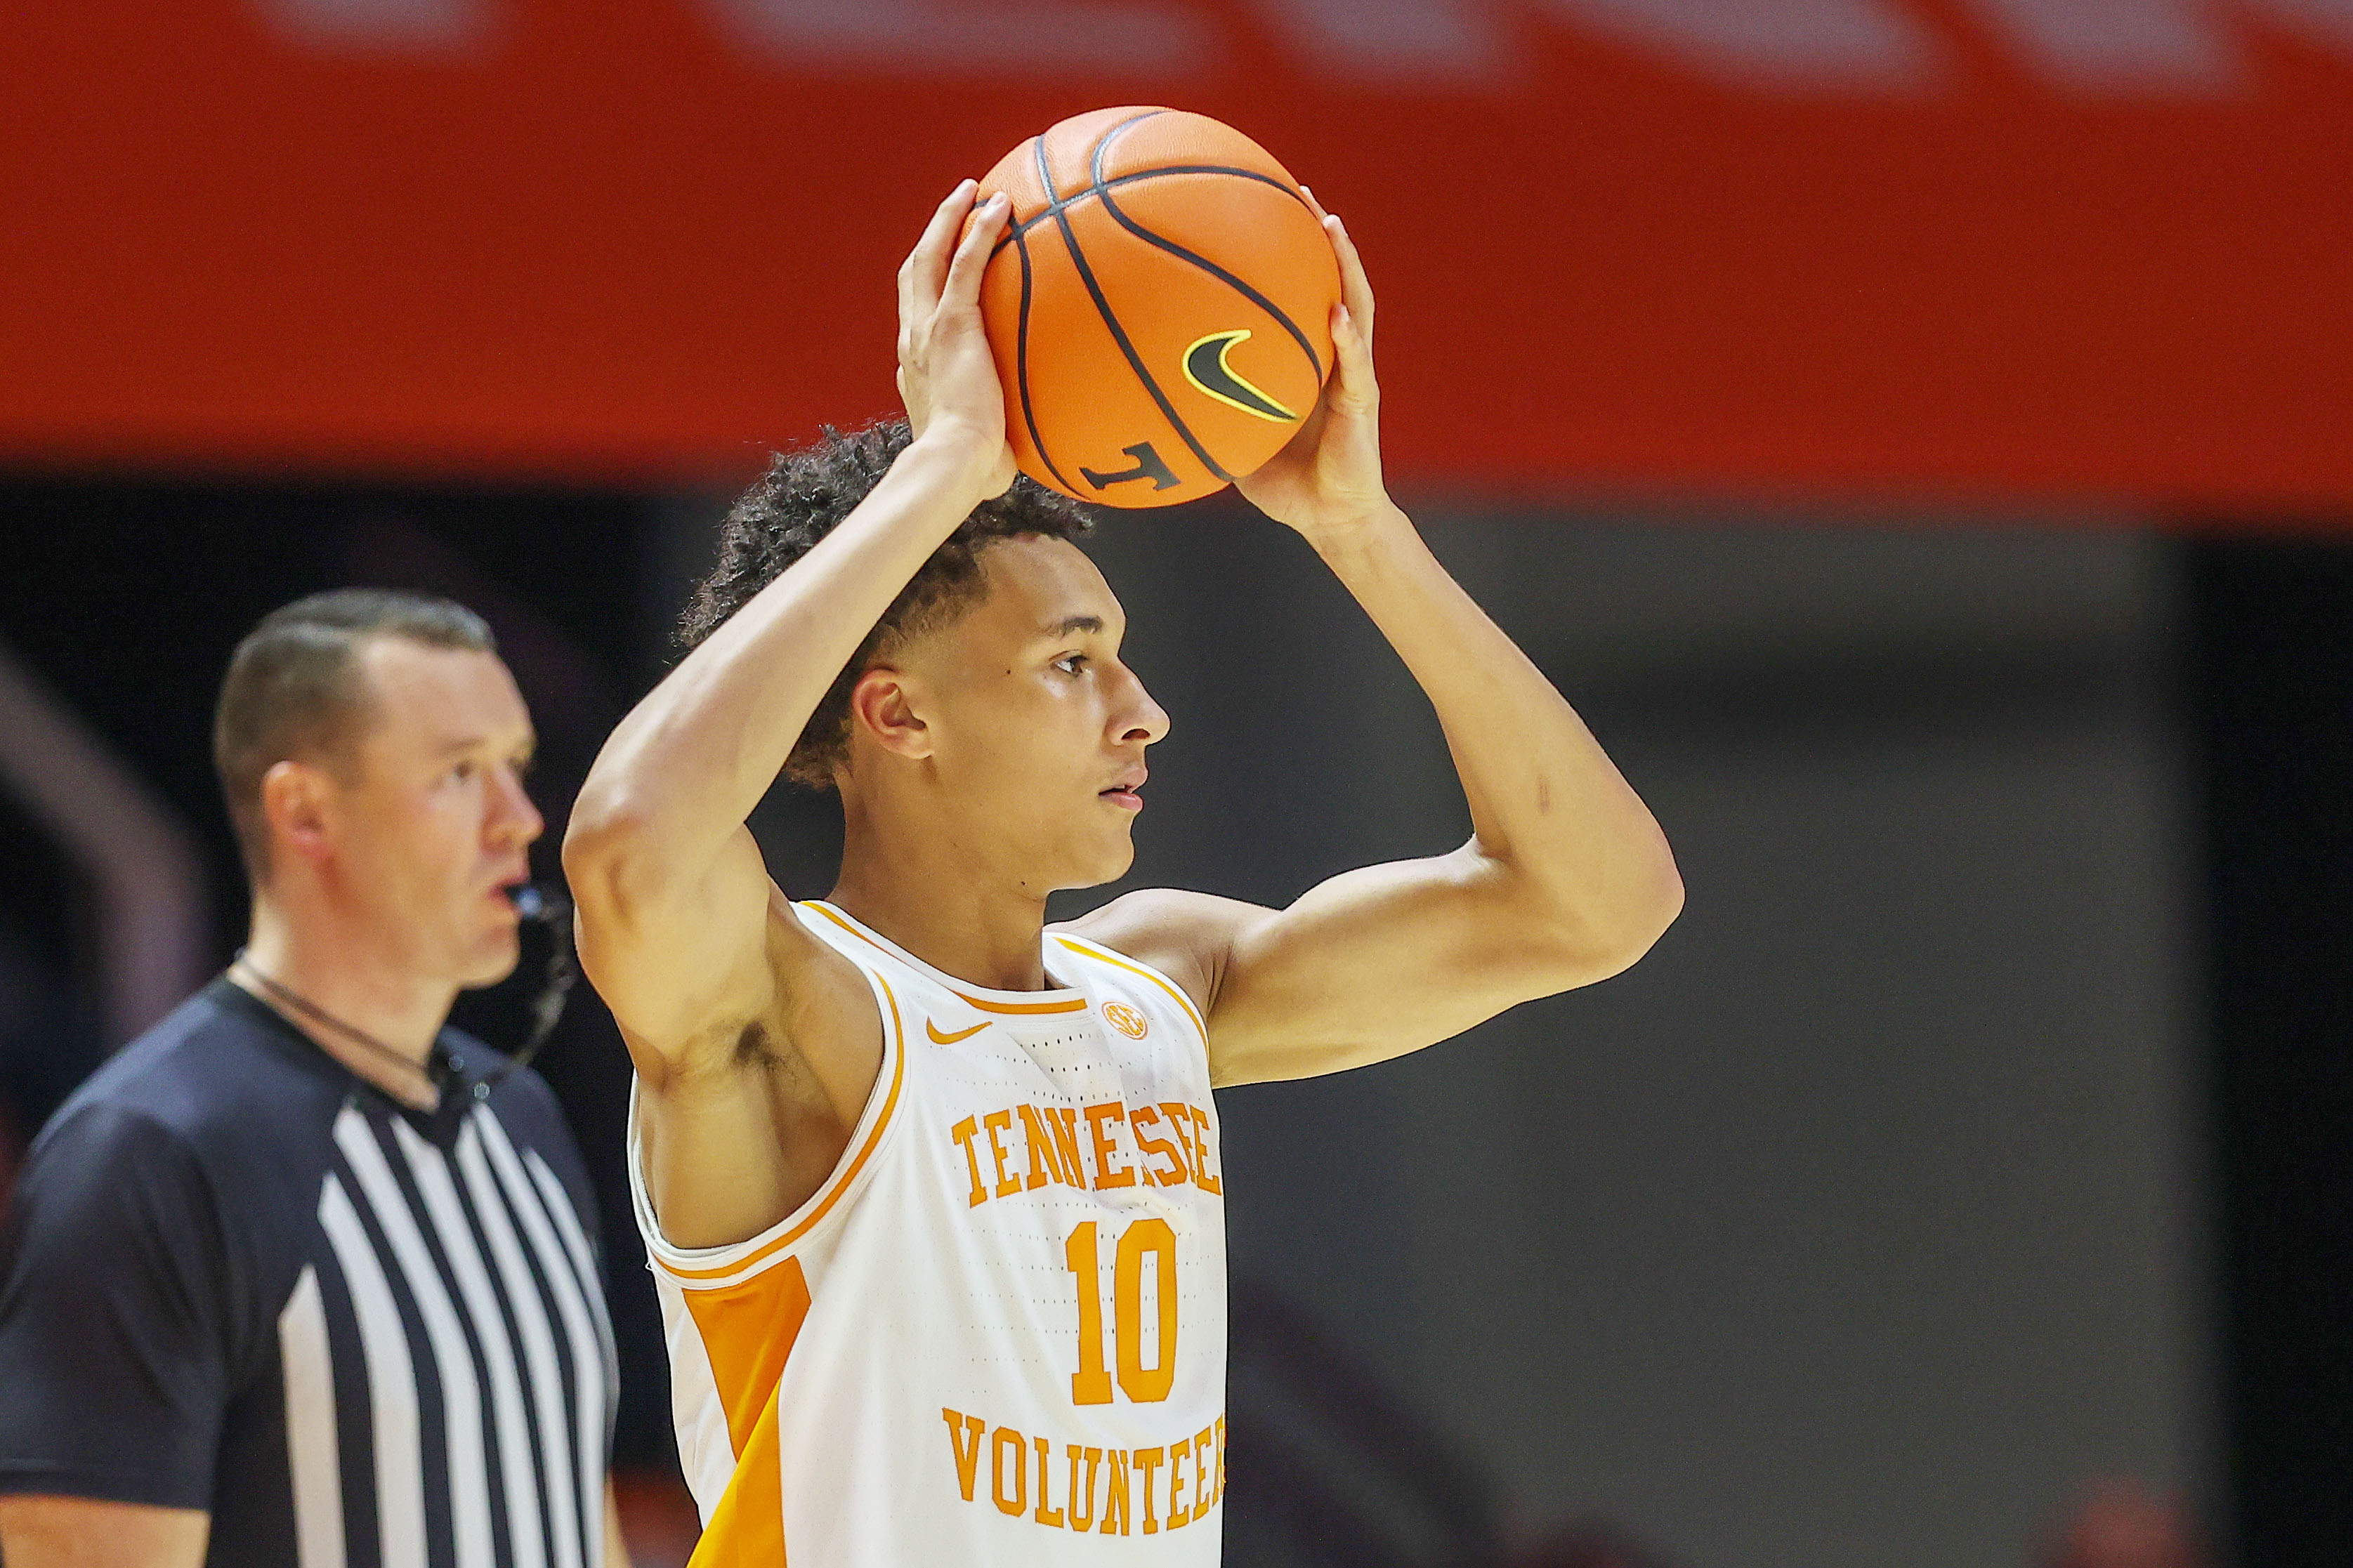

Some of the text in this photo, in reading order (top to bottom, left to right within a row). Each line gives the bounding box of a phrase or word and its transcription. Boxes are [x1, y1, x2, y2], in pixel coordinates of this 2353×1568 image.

[1080, 442, 1181, 491] T
[1104, 1003, 1145, 1037] SEC
[952, 1101, 1221, 1208] TENNESEE
[1066, 1218, 1177, 1405] 10
